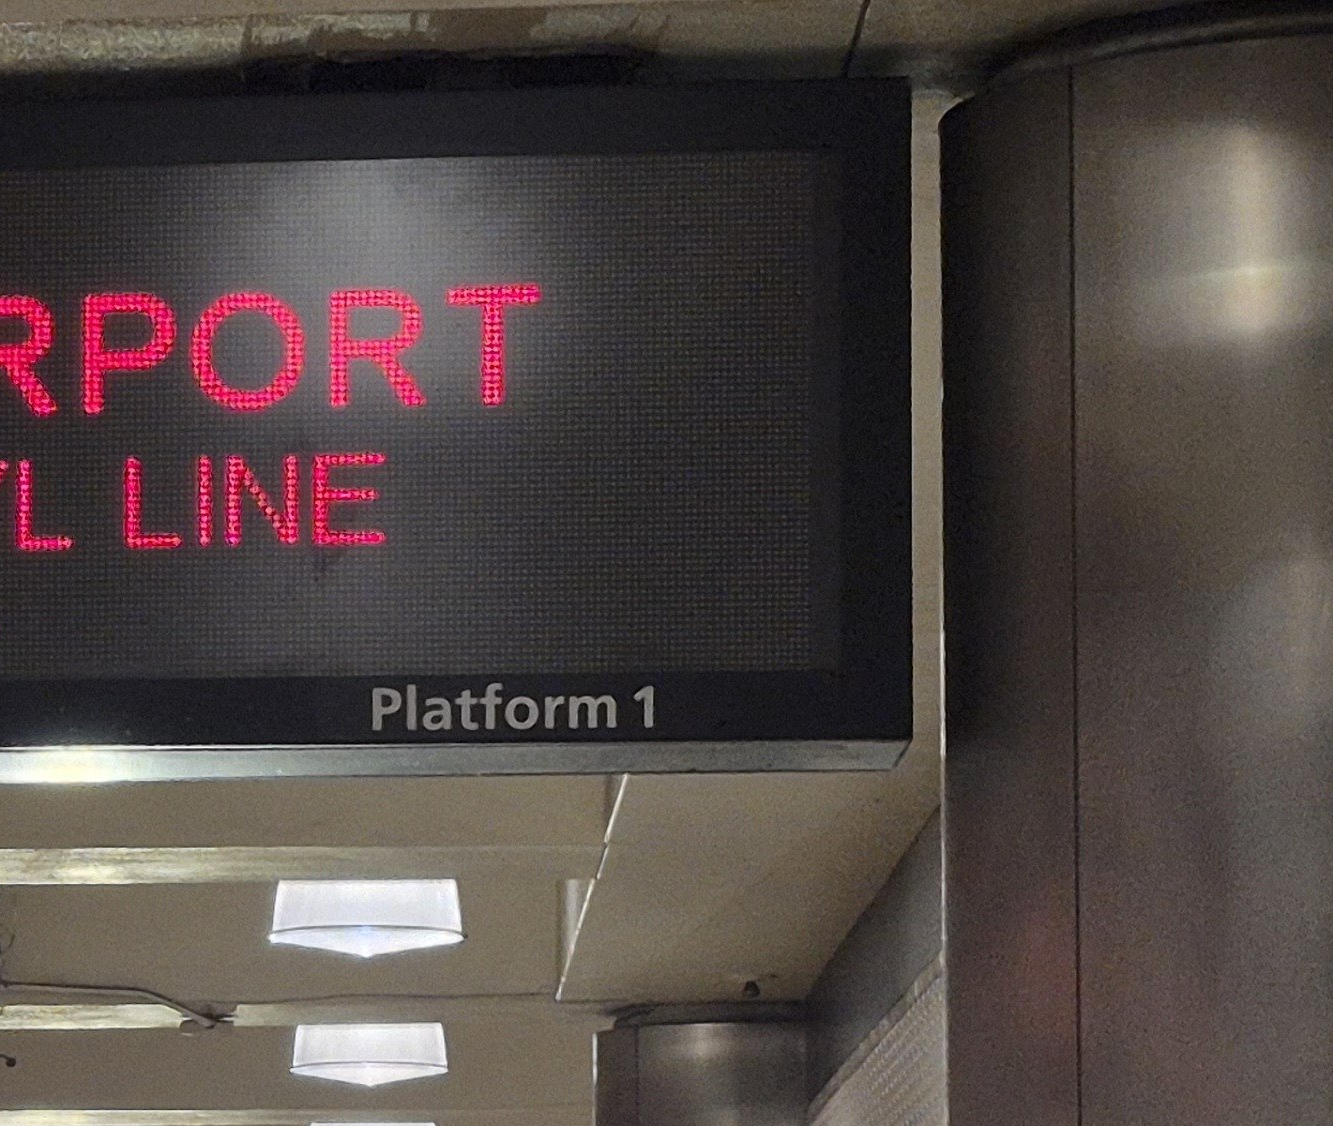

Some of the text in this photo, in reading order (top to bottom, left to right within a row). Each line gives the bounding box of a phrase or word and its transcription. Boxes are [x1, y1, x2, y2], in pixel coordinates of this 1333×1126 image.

[121, 452, 388, 551] LINE
[370, 682, 655, 731] Platform 1
